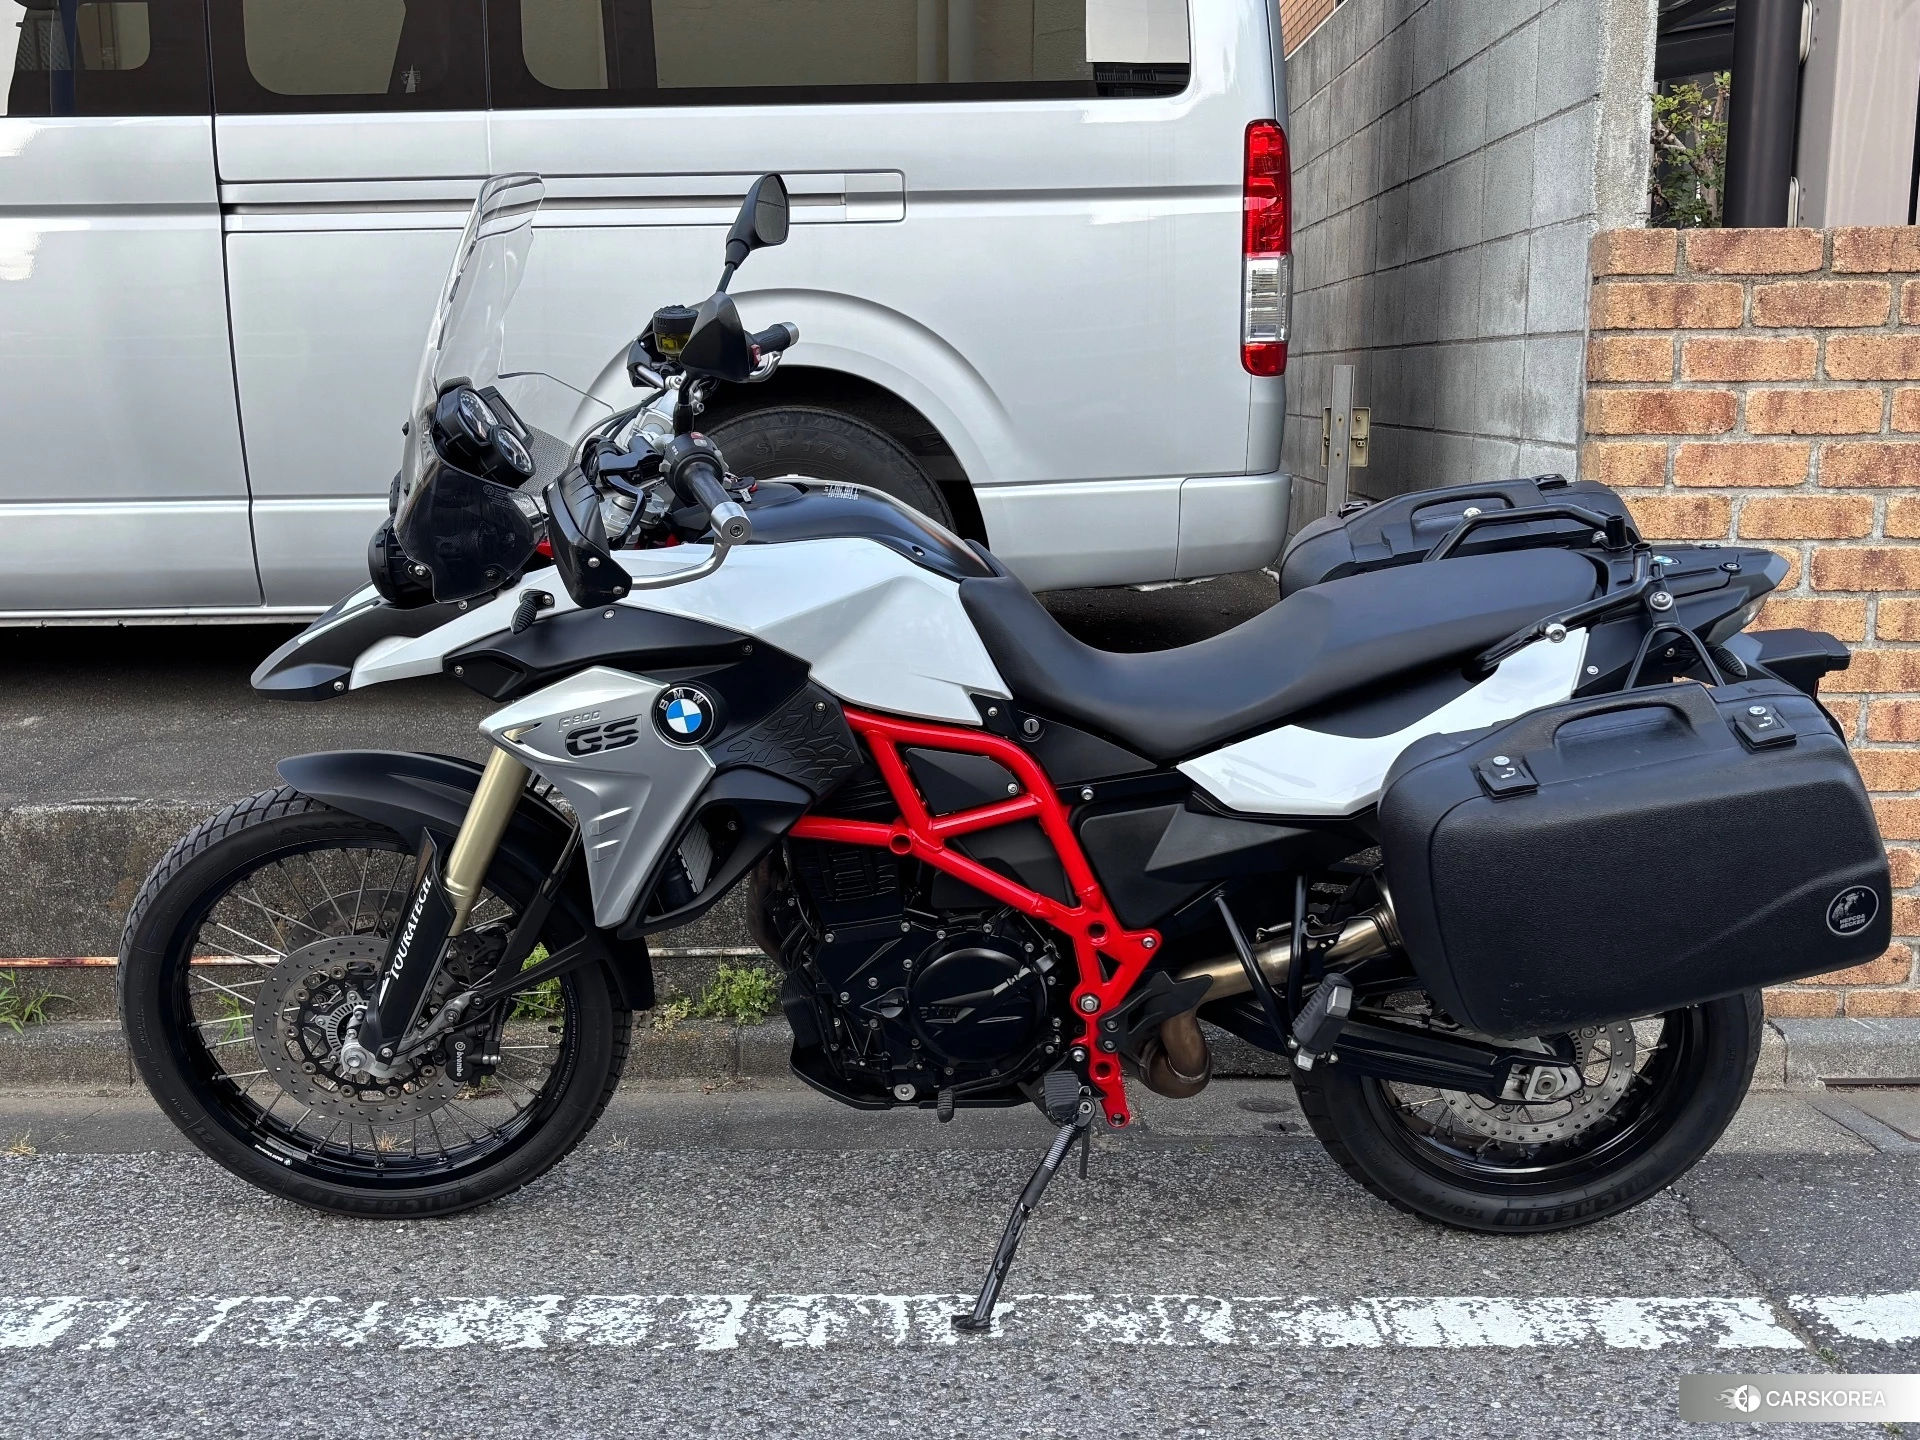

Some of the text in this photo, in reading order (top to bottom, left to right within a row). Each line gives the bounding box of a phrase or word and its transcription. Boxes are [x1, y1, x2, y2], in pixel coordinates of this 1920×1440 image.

[756, 439, 792, 455] SP
[802, 440, 848, 460] 175
[659, 689, 704, 711] BMW
[565, 717, 640, 757] GS
[390, 875, 432, 980] TOURATECH
[456, 1051, 464, 1077] brembo
[301, 1189, 461, 1213] MICHELIN
[1503, 1173, 1652, 1225] MICHELIN
